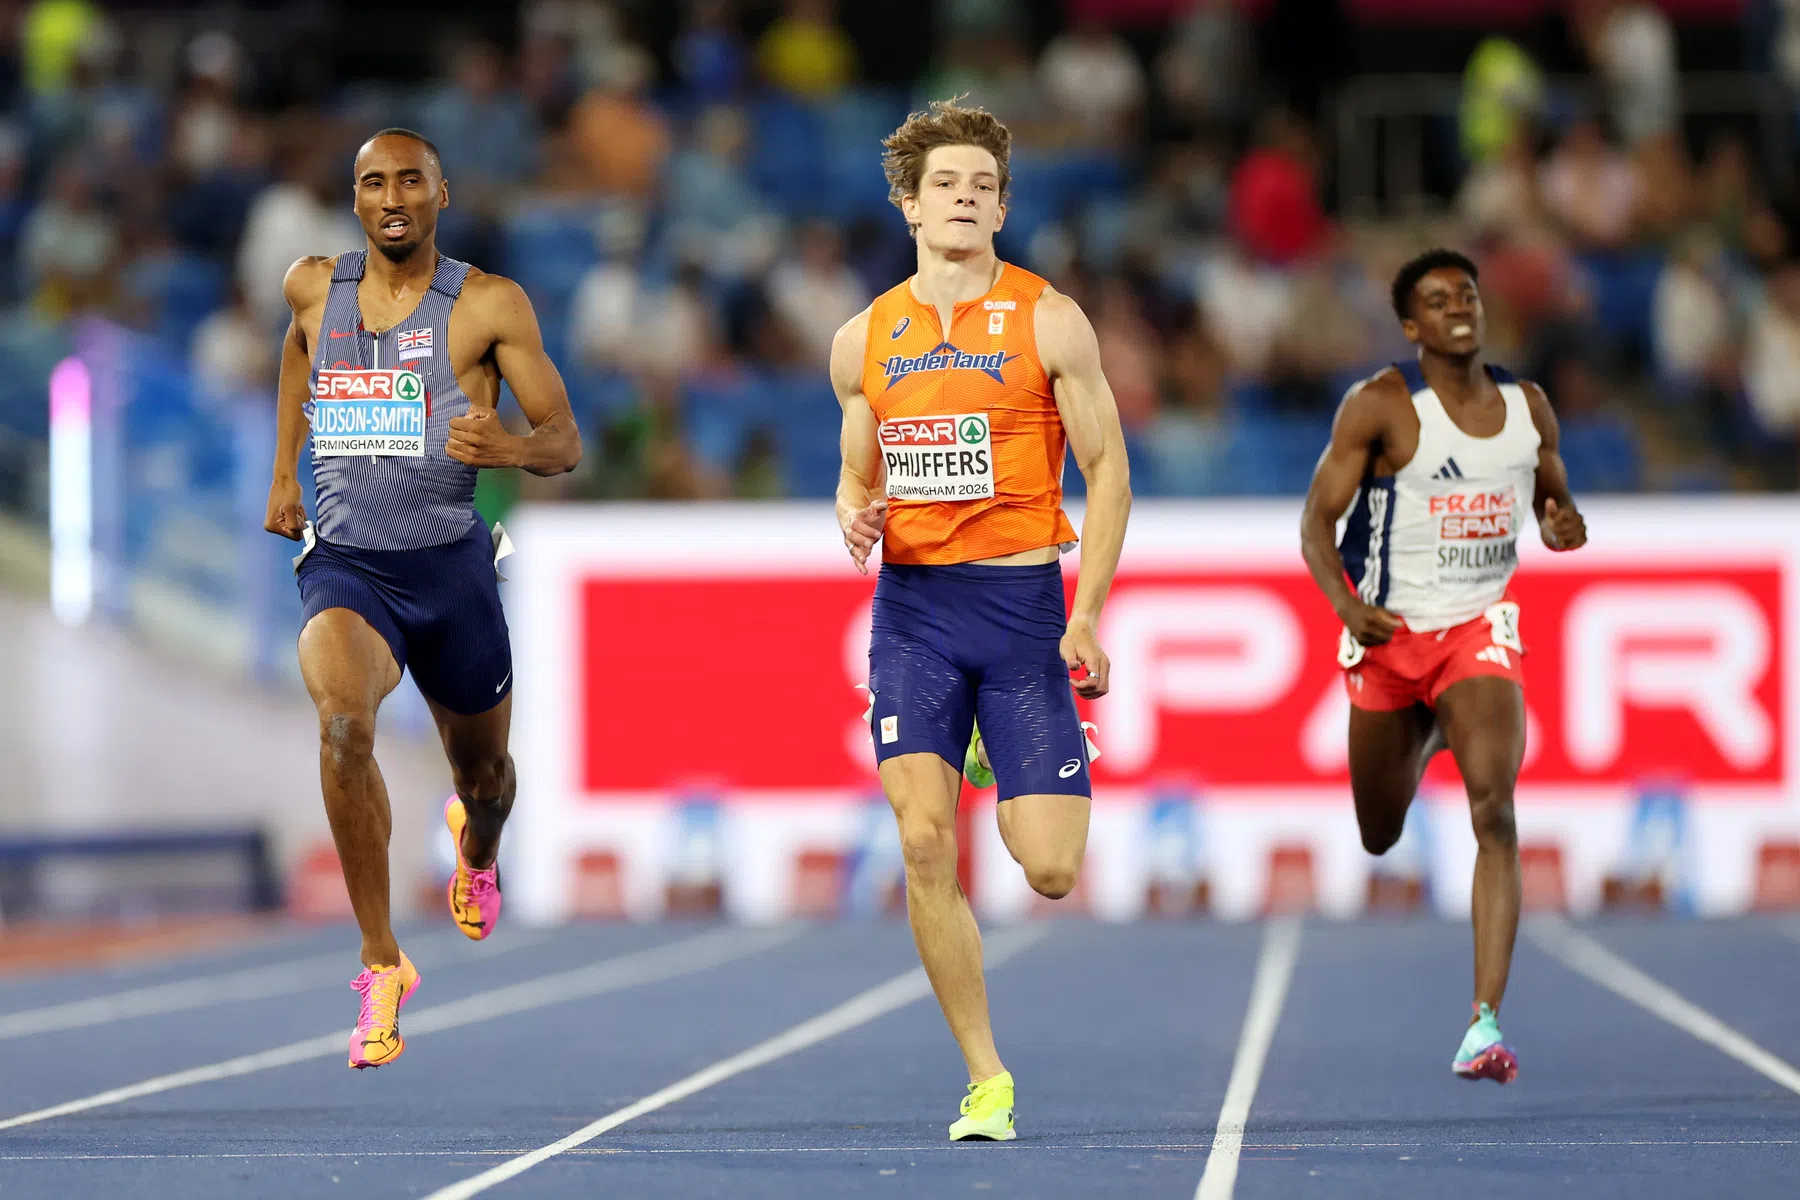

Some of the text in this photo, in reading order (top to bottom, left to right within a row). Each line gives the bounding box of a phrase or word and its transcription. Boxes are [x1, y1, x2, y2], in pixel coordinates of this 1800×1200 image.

[316, 376, 391, 396] SPAR
[313, 406, 421, 433] UDSON-SMITH
[880, 422, 954, 442] SPAR
[316, 439, 419, 451] IRMINGHAM 2026
[886, 450, 989, 477] PHIJFFERS
[888, 484, 989, 496] BIRMINGHAM 2026
[1429, 491, 1515, 515] FRAN
[1444, 513, 1510, 538] SPAR
[844, 582, 1777, 774] PR
